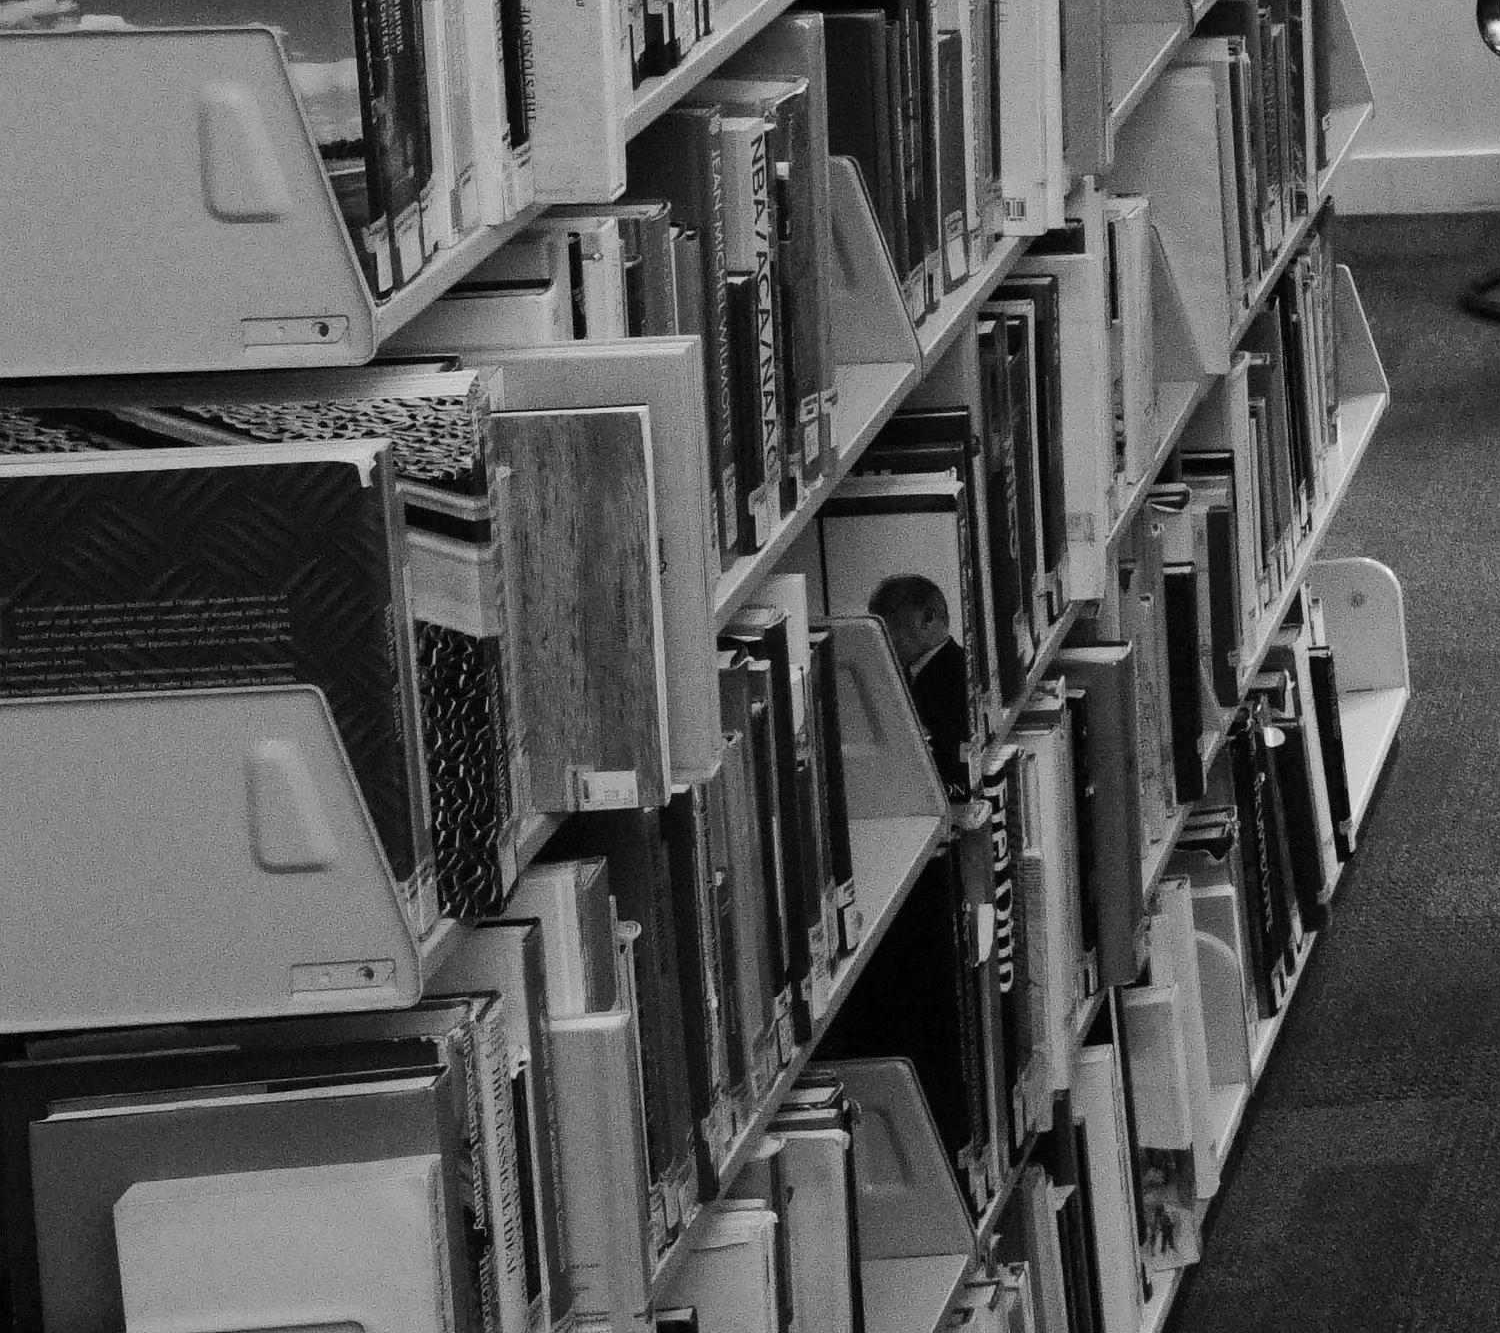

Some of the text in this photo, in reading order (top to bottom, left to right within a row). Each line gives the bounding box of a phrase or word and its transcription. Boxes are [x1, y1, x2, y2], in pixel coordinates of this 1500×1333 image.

[519, 6, 533, 25] OF
[520, 29, 535, 88] STONES
[523, 88, 537, 122] THE
[709, 147, 733, 447] JEAN-MICHEL WILMOTTE
[983, 777, 1012, 872] Frei
[470, 1142, 488, 1237] Germany
[491, 1066, 518, 1283] THE CLASSICAL IDEAL
